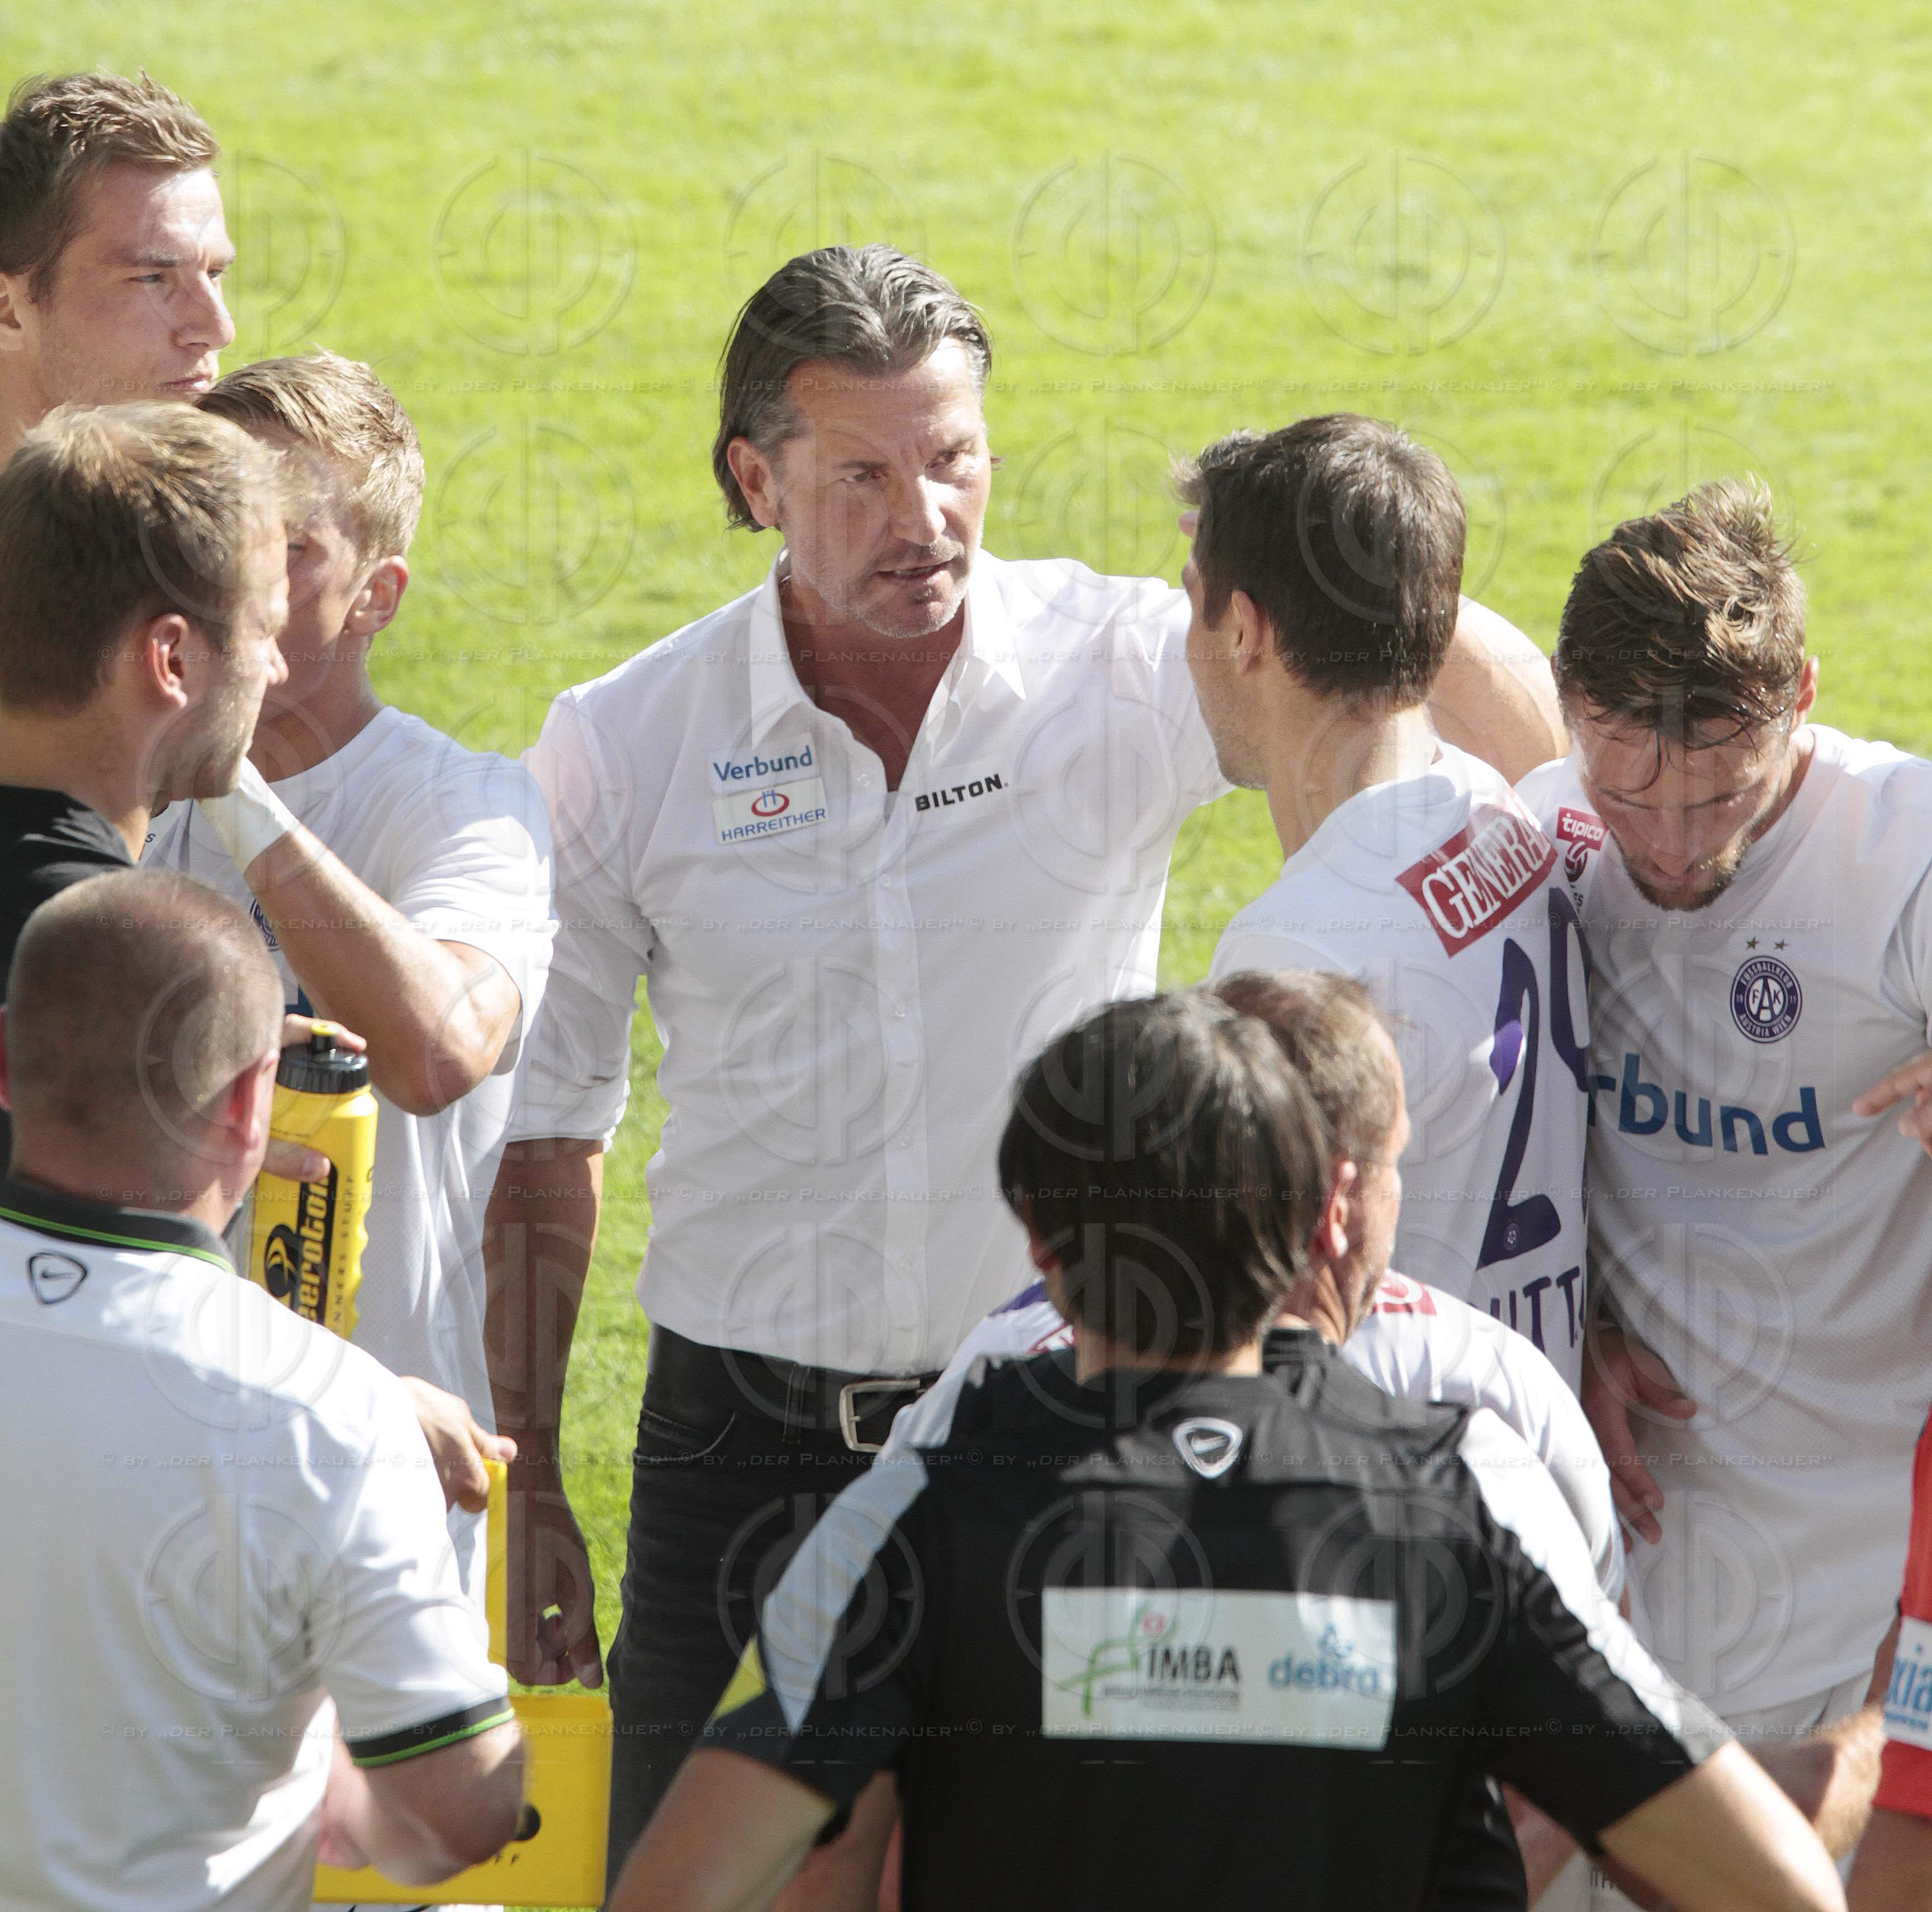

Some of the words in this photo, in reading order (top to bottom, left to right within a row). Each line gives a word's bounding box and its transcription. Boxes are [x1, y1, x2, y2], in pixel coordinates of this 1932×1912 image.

[713, 745, 813, 782] Verbund
[721, 808, 826, 841] HARREITHER
[1562, 812, 1604, 841] tipico
[1587, 1052, 1825, 1155] rbund
[1148, 1643, 1240, 1683] IMBA
[1267, 1652, 1379, 1695] debra
